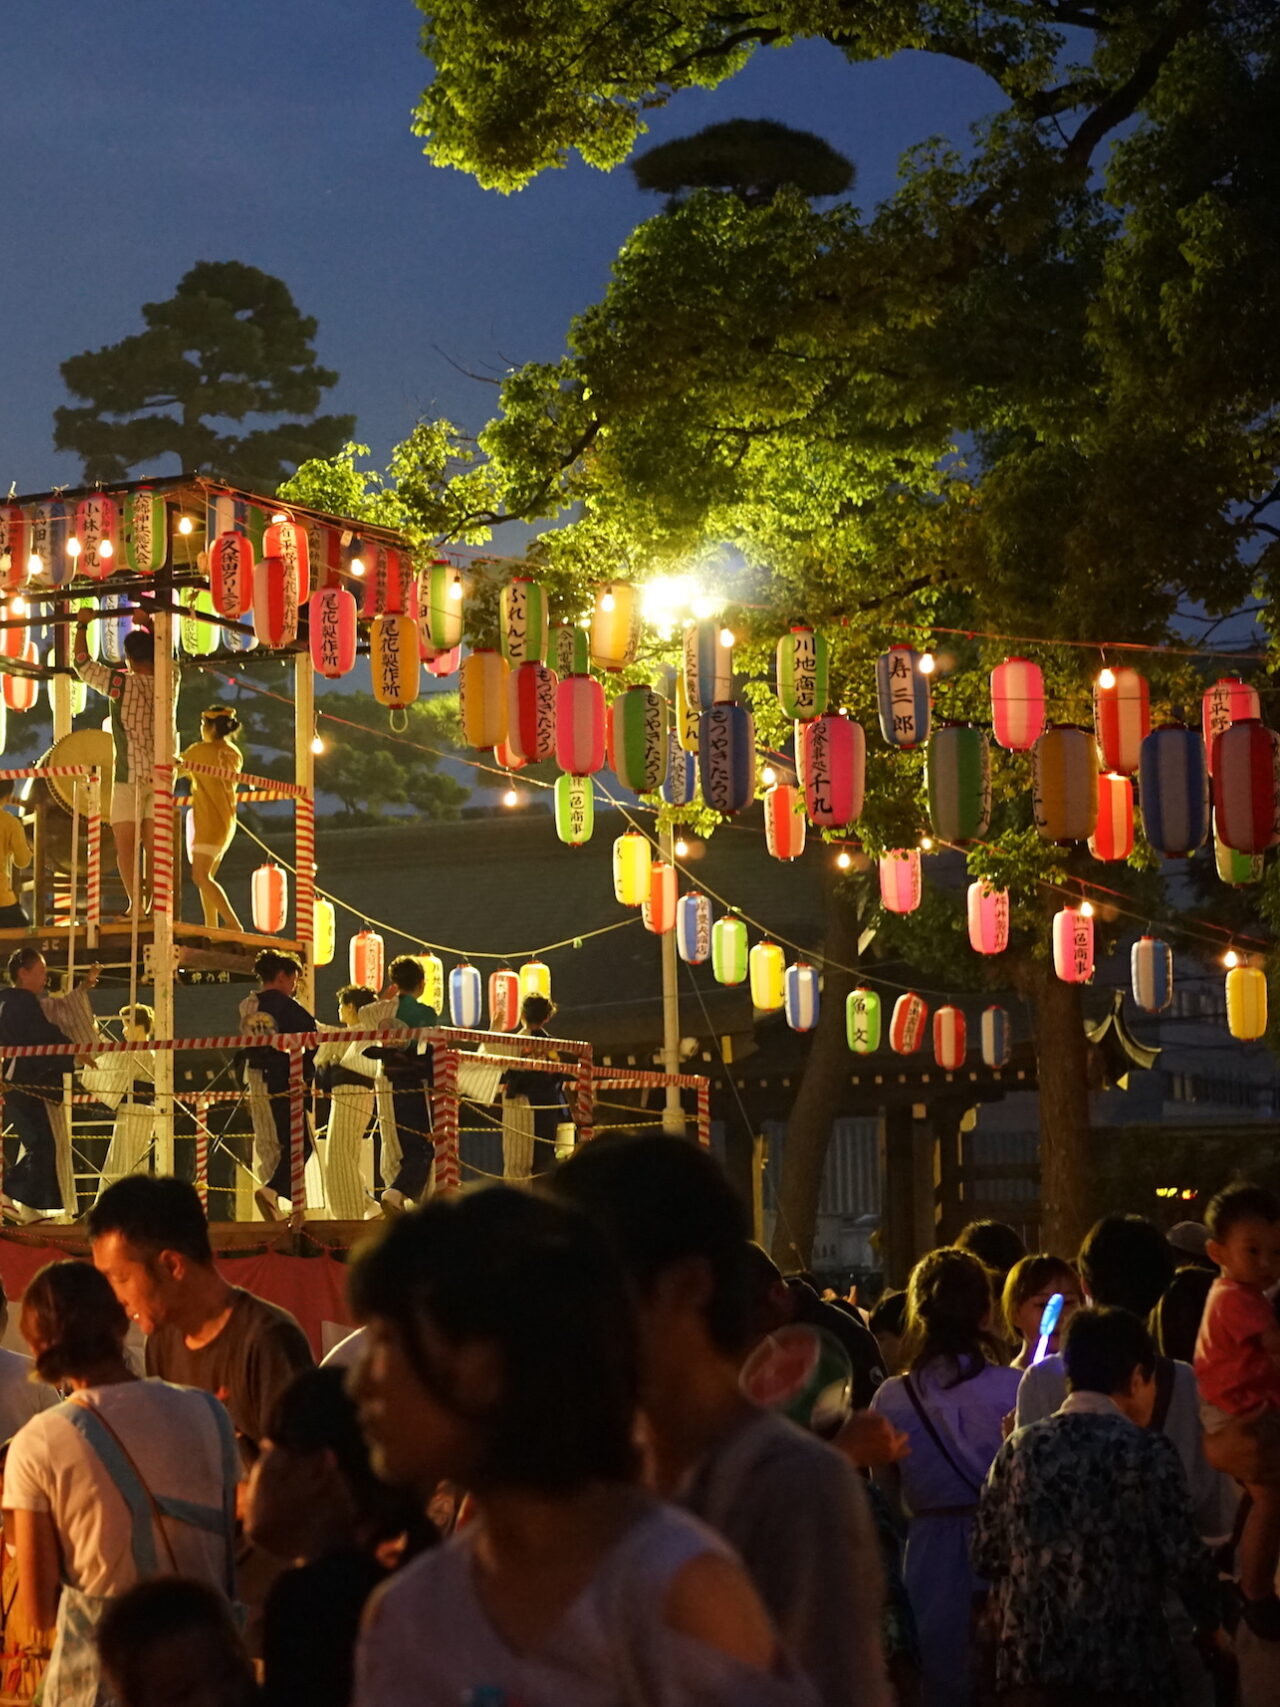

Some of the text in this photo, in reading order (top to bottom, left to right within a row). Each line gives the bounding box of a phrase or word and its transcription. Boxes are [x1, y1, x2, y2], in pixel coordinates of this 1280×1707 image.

[322, 593, 339, 667] 尾花製作所
[379, 618, 401, 698] 尾花製作所
[507, 588, 526, 657] ふれんど
[536, 669, 553, 752] もつやきたろう
[793, 636, 817, 708] 川地商店
[888, 656, 915, 735] 寿三郎
[645, 692, 661, 784] もつやきたろう
[710, 710, 729, 809] もつやきたろう
[808, 721, 833, 816] お食事処千丸
[852, 997, 869, 1045] 魚文
